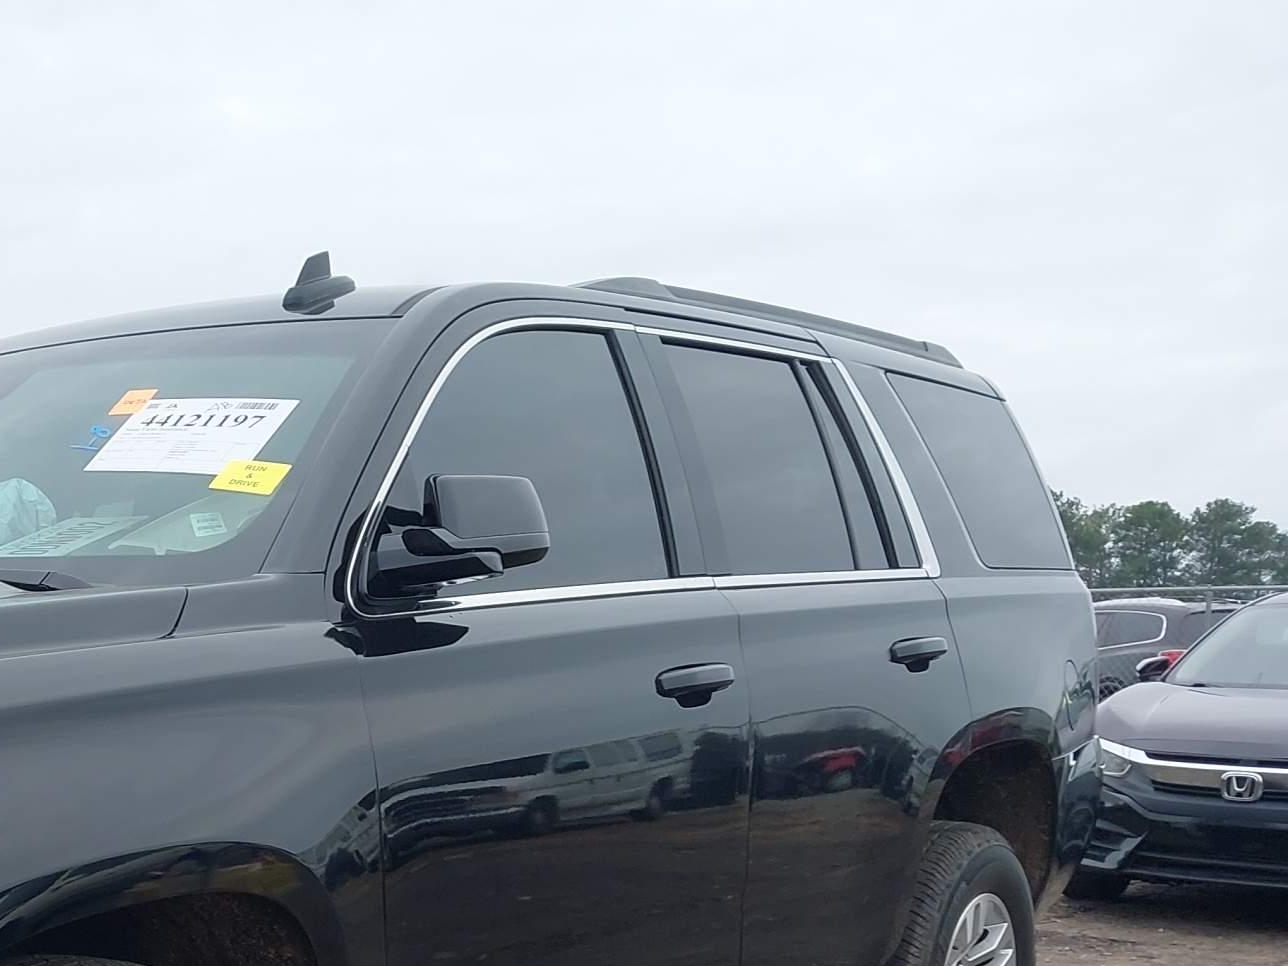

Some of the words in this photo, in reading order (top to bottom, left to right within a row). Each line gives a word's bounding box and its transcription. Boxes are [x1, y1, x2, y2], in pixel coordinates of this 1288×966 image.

[141, 413, 266, 429] 44121197
[244, 464, 268, 472] RUN
[228, 478, 260, 488] DRIVE
